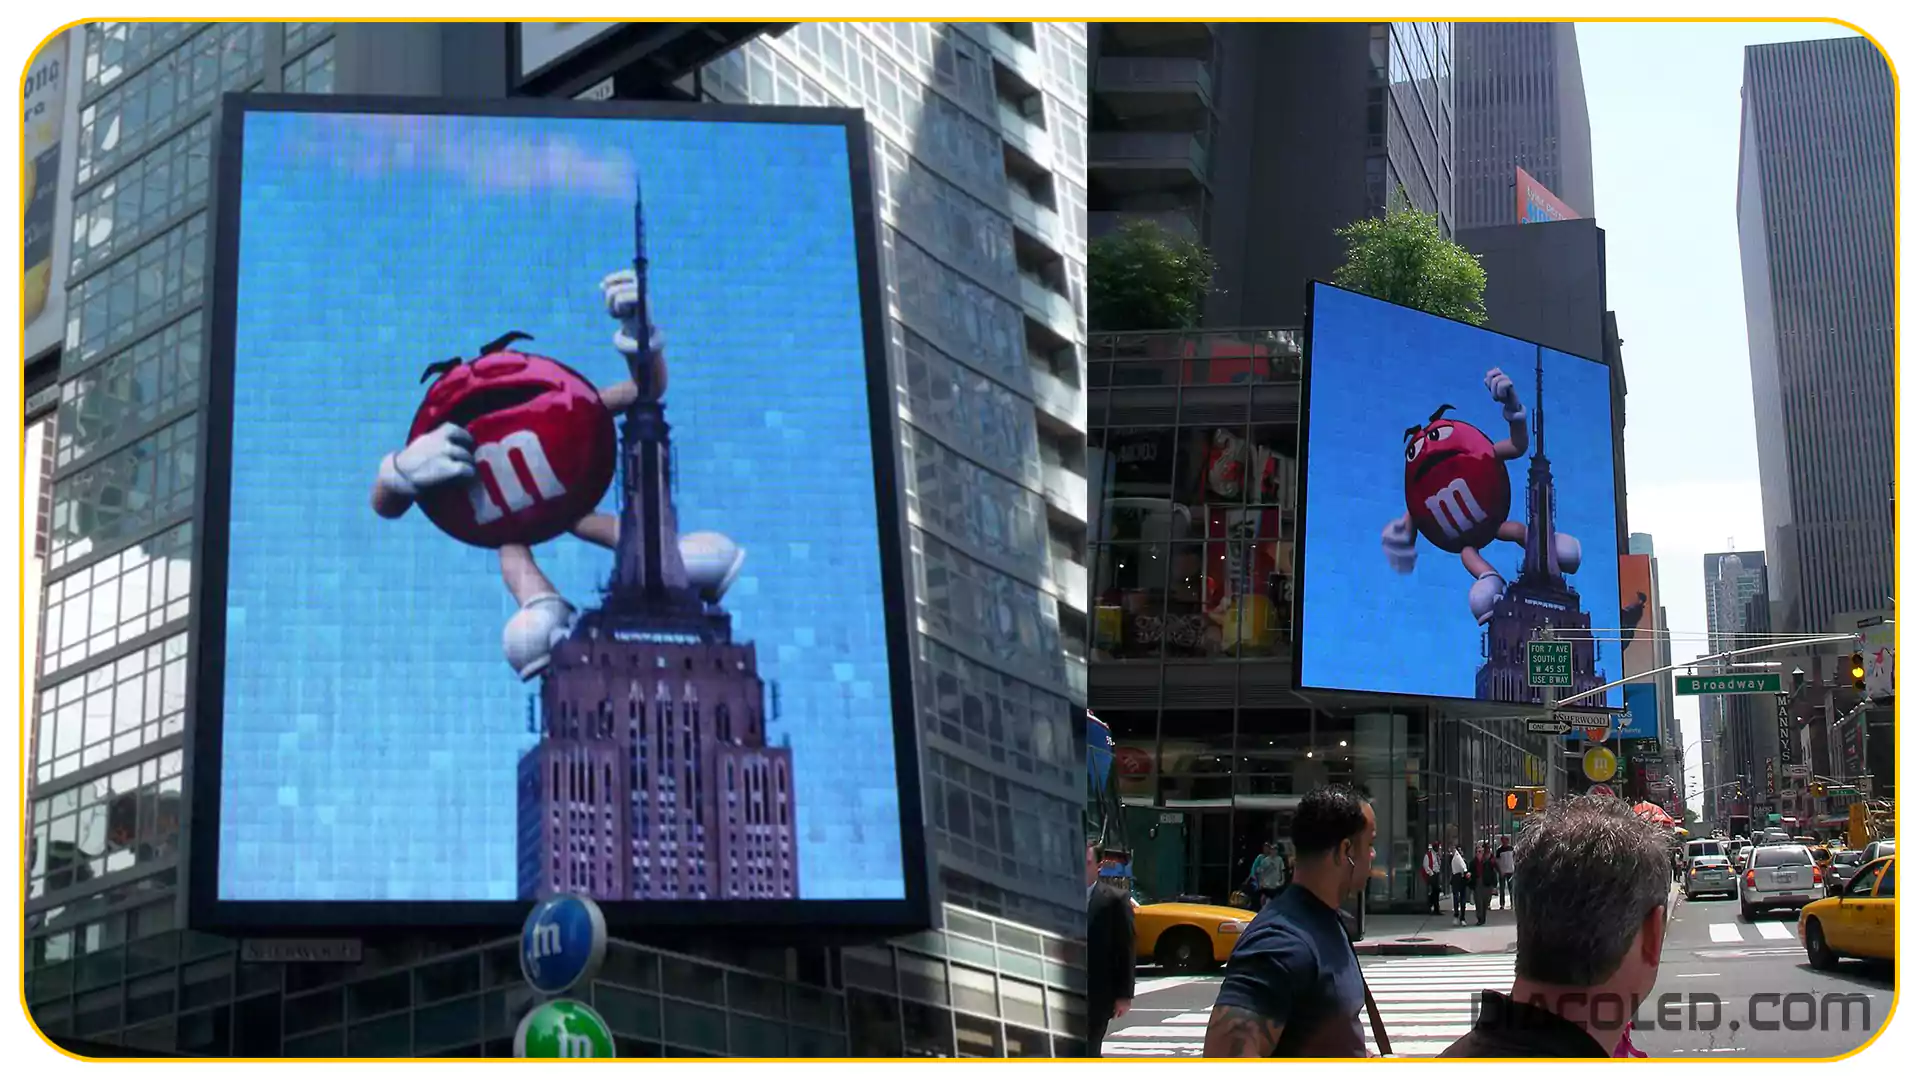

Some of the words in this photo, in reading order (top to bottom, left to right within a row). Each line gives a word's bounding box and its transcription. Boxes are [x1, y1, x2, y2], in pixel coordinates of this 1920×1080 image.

[1424, 478, 1488, 540] m
[1531, 645, 1545, 653] FOR
[1548, 645, 1552, 653] 7
[1555, 645, 1568, 653] AVE
[1532, 655, 1555, 663] SOUTH
[1558, 655, 1567, 663] OF
[1536, 665, 1541, 673] W
[1544, 665, 1554, 673] 45
[1556, 665, 1565, 673] ST
[1691, 678, 1765, 690] Broadway
[1559, 713, 1606, 725] SHERWOOD
[1553, 723, 1567, 731] WAY
[532, 922, 562, 958] m
